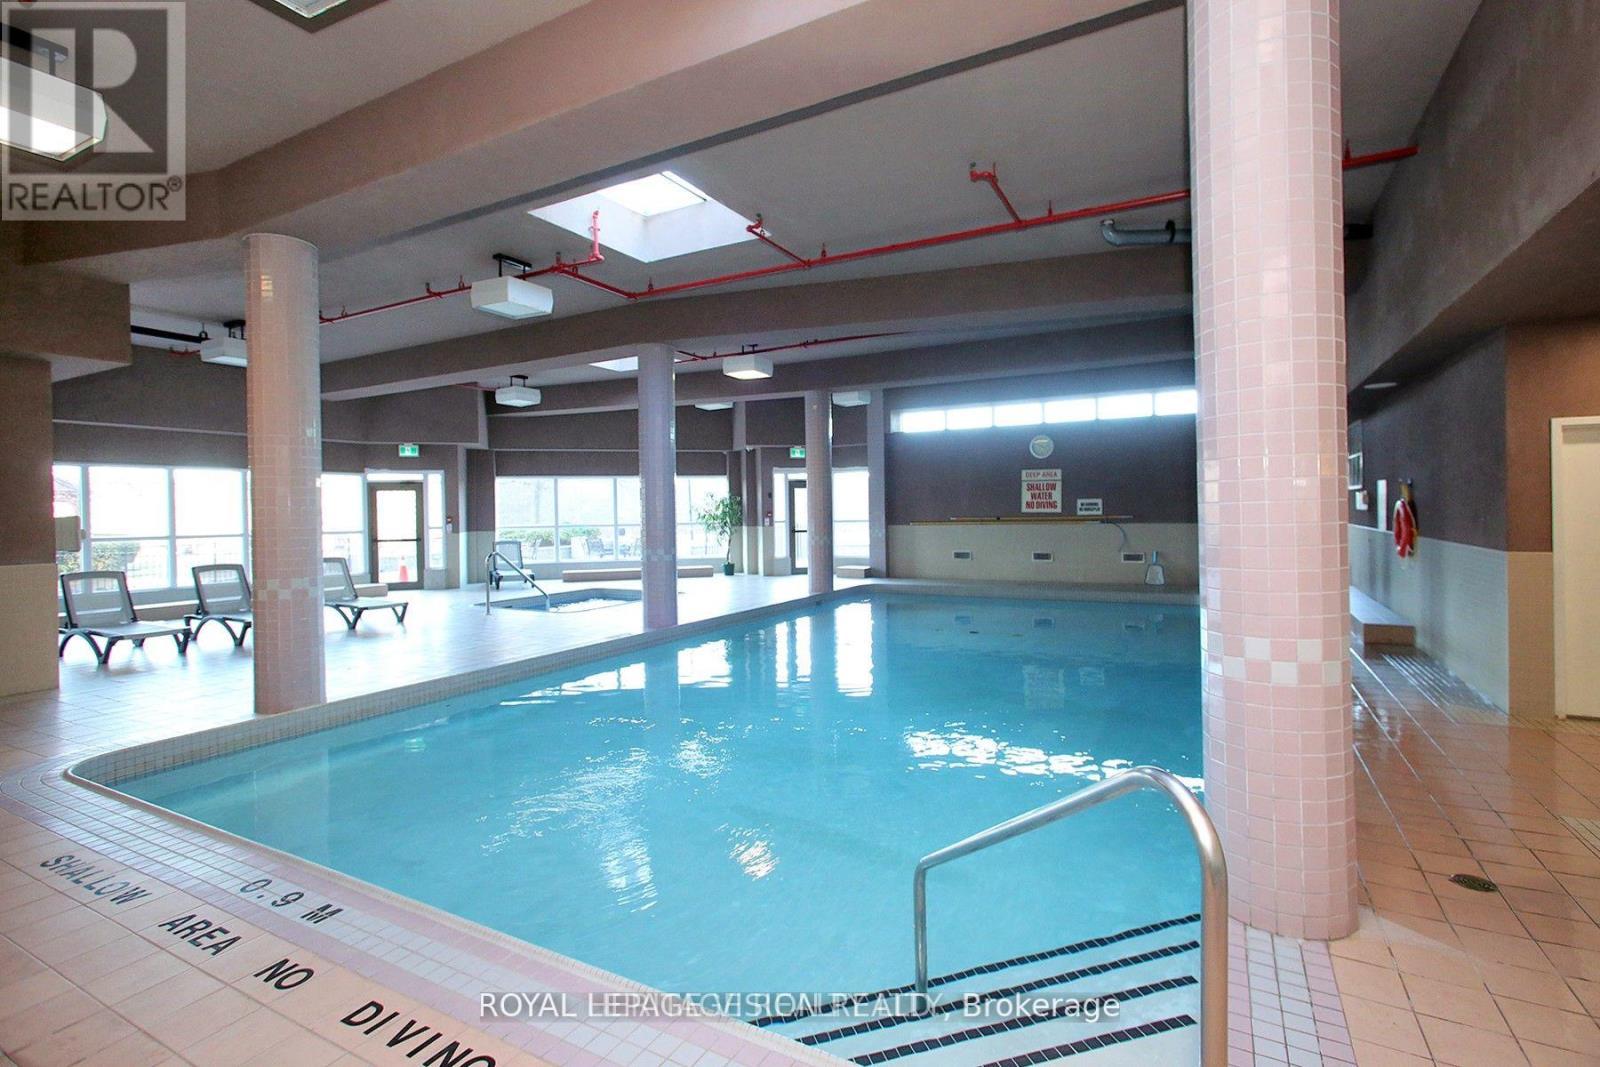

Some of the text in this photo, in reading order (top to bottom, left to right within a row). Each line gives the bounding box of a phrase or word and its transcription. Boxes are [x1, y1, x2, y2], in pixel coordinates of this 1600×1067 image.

[1026, 482, 1057, 491] SHALLOW
[1030, 492, 1053, 500] WATER
[1025, 501, 1058, 509] NO DIVING
[240, 878, 344, 925] 0.9 M
[40, 855, 151, 905] SHALLOW
[158, 913, 243, 957] AREA
[253, 957, 315, 990] NO
